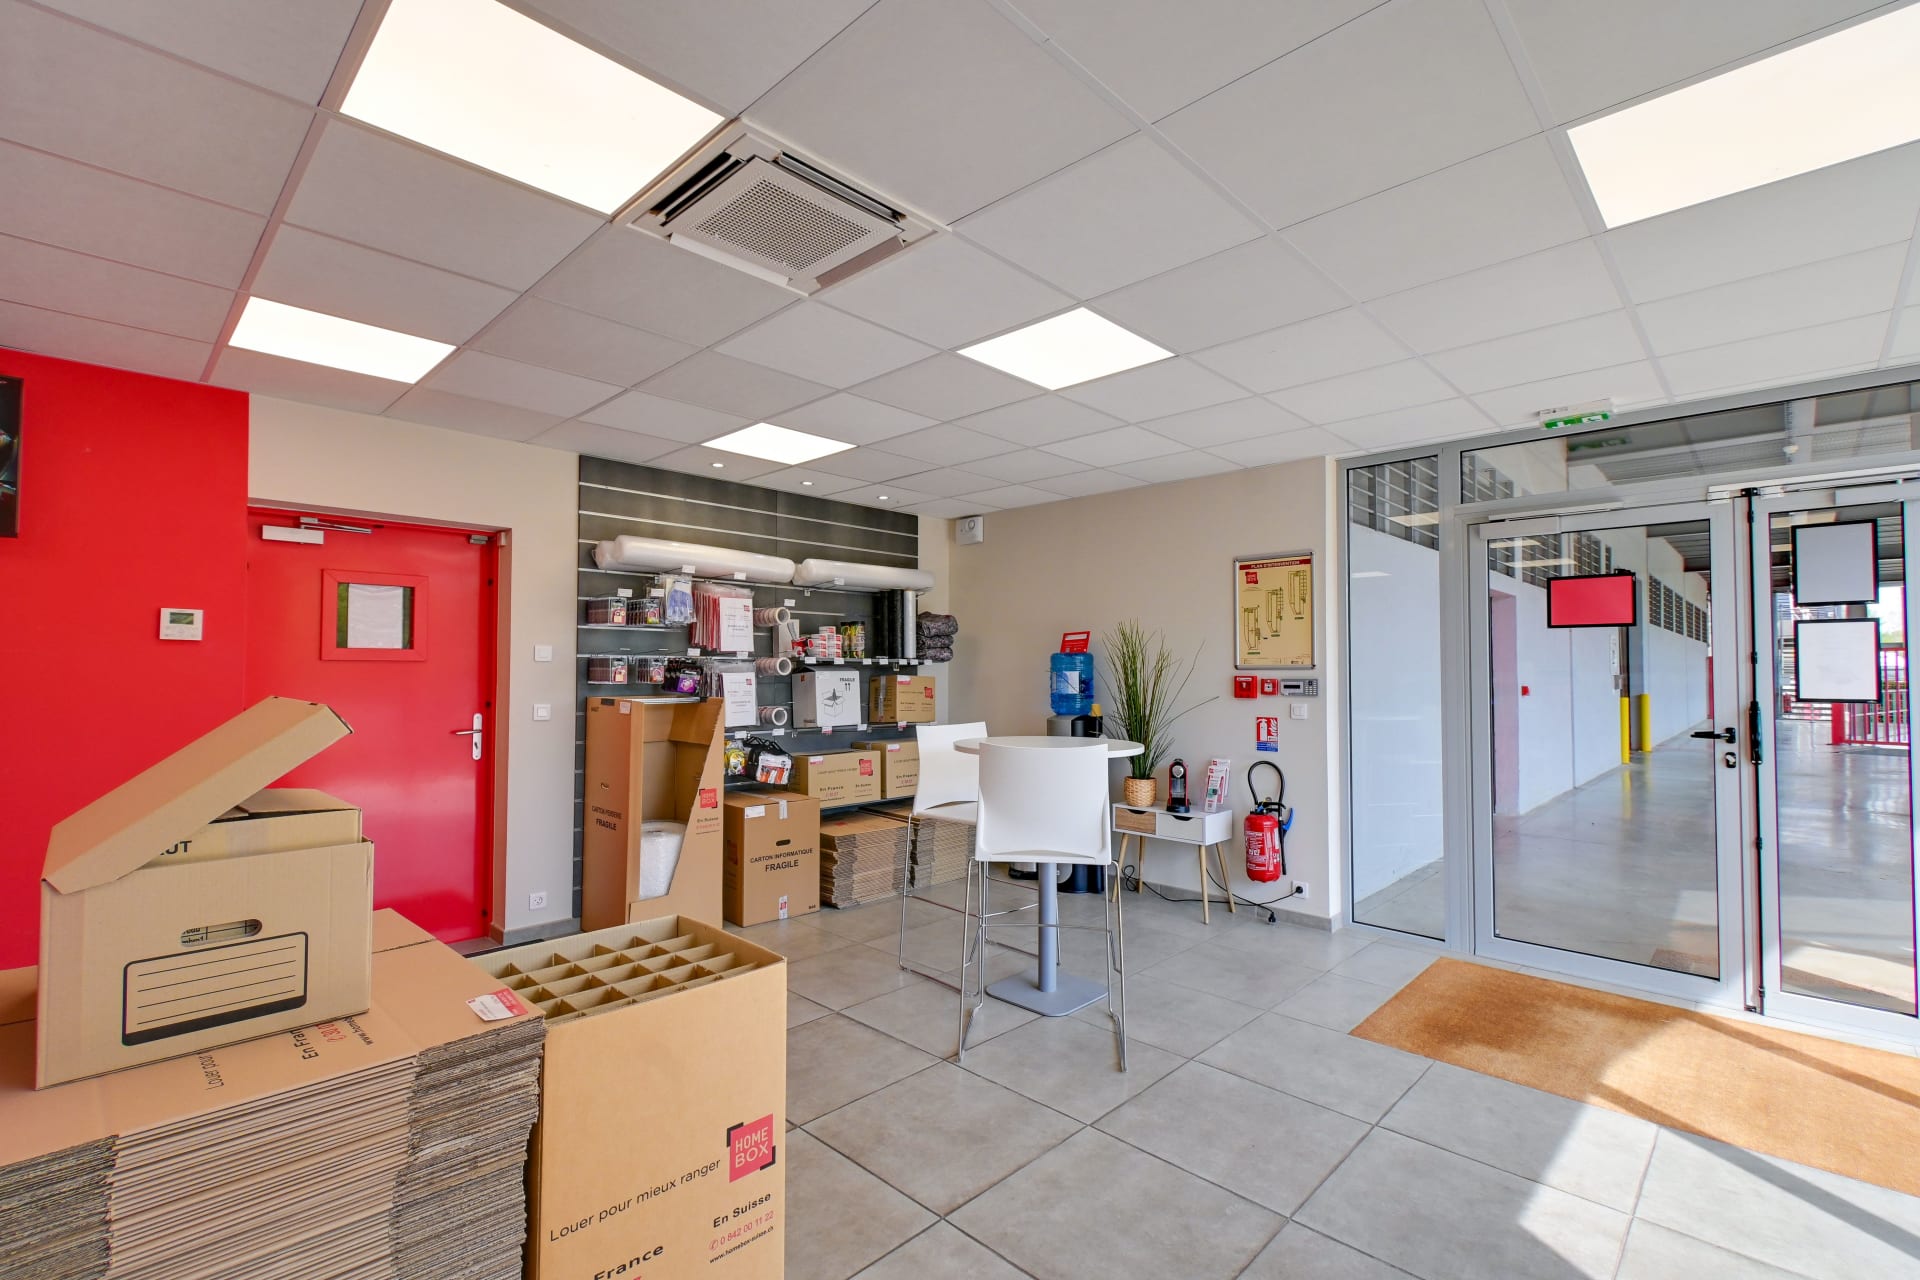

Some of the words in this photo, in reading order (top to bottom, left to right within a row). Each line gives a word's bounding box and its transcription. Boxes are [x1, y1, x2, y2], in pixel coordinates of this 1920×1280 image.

[595, 818, 617, 831] FRAGILE
[750, 855, 773, 864] CARTON
[774, 848, 813, 859] INFORMATIQUE
[765, 860, 799, 872] FRAGILE
[302, 1046, 319, 1060] En
[735, 1126, 769, 1154] HOME
[735, 1141, 769, 1169] BOX
[549, 1215, 595, 1242] Louer
[598, 1198, 633, 1224] pour
[636, 1178, 676, 1204] mieux
[680, 1158, 721, 1185] ranger
[713, 1215, 729, 1228] En
[732, 1193, 771, 1218] Suisse
[727, 1227, 742, 1242] 842
[743, 1222, 753, 1233] 00
[755, 1216, 763, 1227] 11
[764, 1210, 775, 1222] 22
[709, 1225, 774, 1264] www.homebox-suisse.ch
[594, 1245, 664, 1280] France
